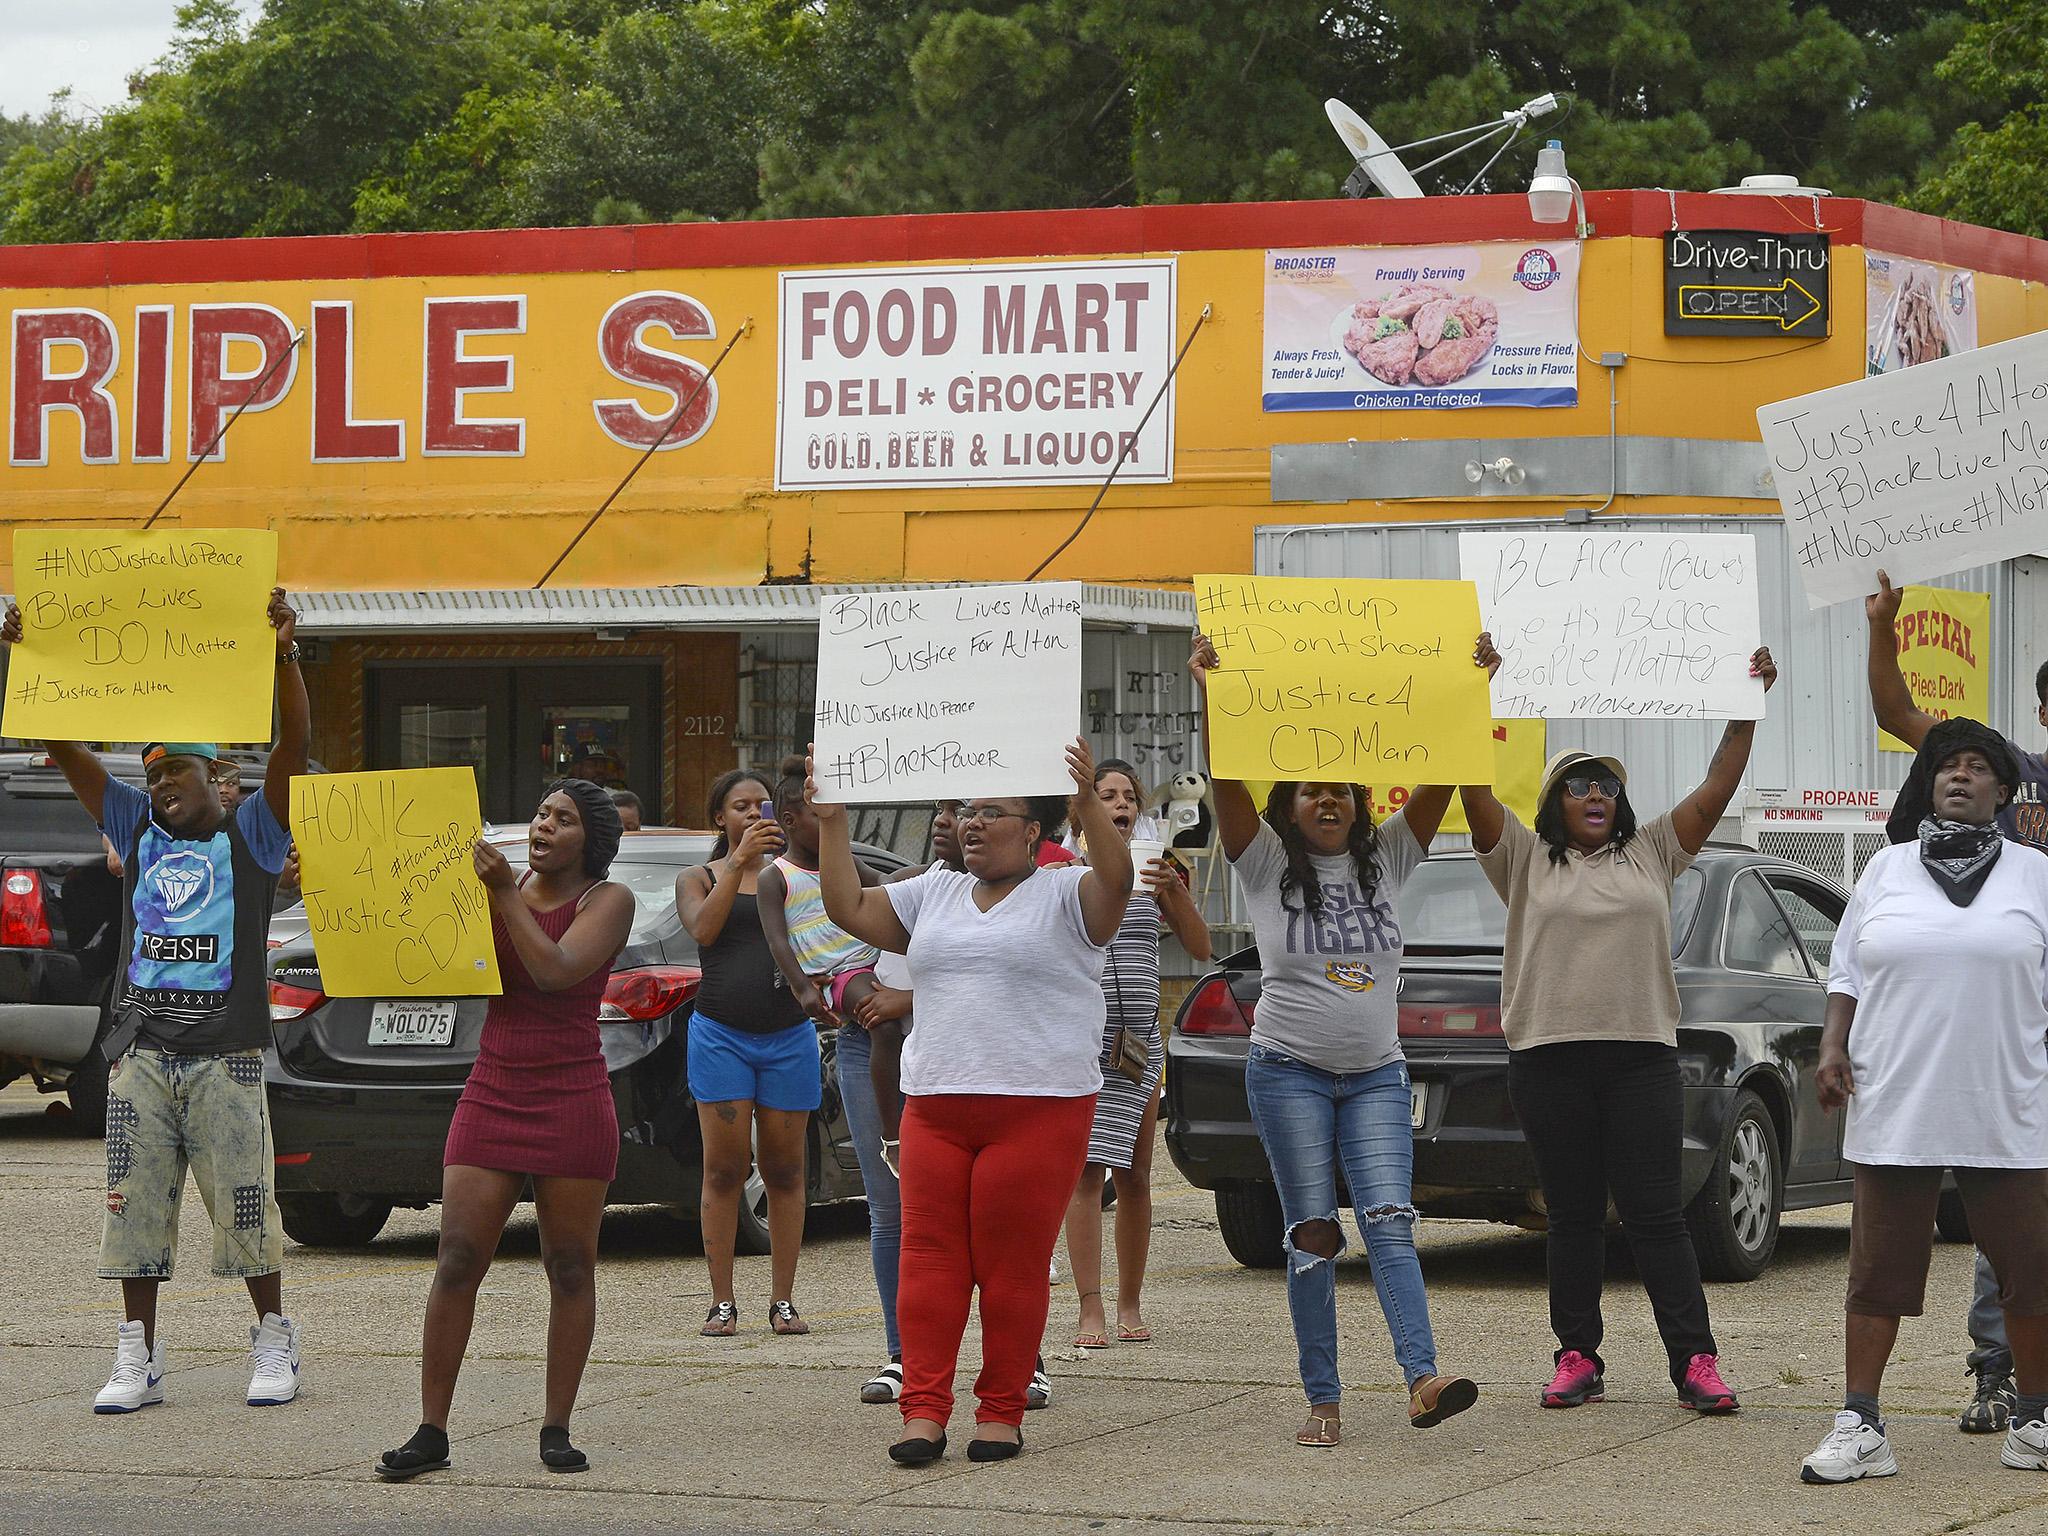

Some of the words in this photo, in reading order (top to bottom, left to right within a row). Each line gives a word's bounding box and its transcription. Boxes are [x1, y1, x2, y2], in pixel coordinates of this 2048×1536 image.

[1274, 257, 1336, 270] BROASTER
[1672, 236, 1828, 270] Drive-Thru
[1375, 267, 1418, 281] Proudly
[1422, 266, 1466, 281] Serving
[1512, 272, 1561, 282] BROASTER
[1688, 292, 1789, 315] OPEN
[801, 286, 958, 361] FOOD
[982, 282, 1149, 355] MART
[1273, 349, 1309, 363] Always
[1311, 348, 1342, 363] Fresh,
[1493, 344, 1543, 357] Pressure
[1545, 343, 1575, 357] Fried,
[9, 293, 528, 468] RIPLE
[592, 290, 719, 452] S
[1271, 367, 1305, 380] Tender
[1305, 369, 1314, 379] &
[1313, 366, 1346, 381] Juicy!
[1491, 363, 1524, 377] Locks
[1526, 364, 1538, 376] in
[1540, 362, 1575, 376] Flavor.
[804, 377, 907, 418] DELI
[947, 371, 1144, 414] GROCERY
[1353, 392, 1411, 409] Chicken
[1413, 392, 1483, 407] Perfected.
[1976, 363, 2048, 427] Alto
[887, 430, 954, 469] BEER
[968, 433, 988, 467] &
[1003, 431, 1140, 467] LIQUOR
[25, 590, 121, 630] Black
[137, 587, 202, 610] Lives
[829, 595, 929, 635] Black
[955, 596, 1011, 622] Lives
[79, 620, 149, 665] DO
[860, 635, 957, 687] Justice
[969, 630, 994, 658] For
[1001, 628, 1069, 659] Alton
[1939, 674, 1966, 701] Dark
[683, 716, 727, 737] 2112
[1803, 790, 1879, 806] PROPANE
[298, 779, 431, 849] HONK
[1764, 809, 1777, 821] NO
[1780, 809, 1823, 821] SMOKING
[352, 847, 377, 891] 4
[1310, 882, 1372, 911] SU
[303, 888, 419, 934] Justice
[1282, 900, 1402, 955] TIGERS
[274, 968, 320, 977] ELANTRA
[394, 1003, 433, 1014] Louisiana
